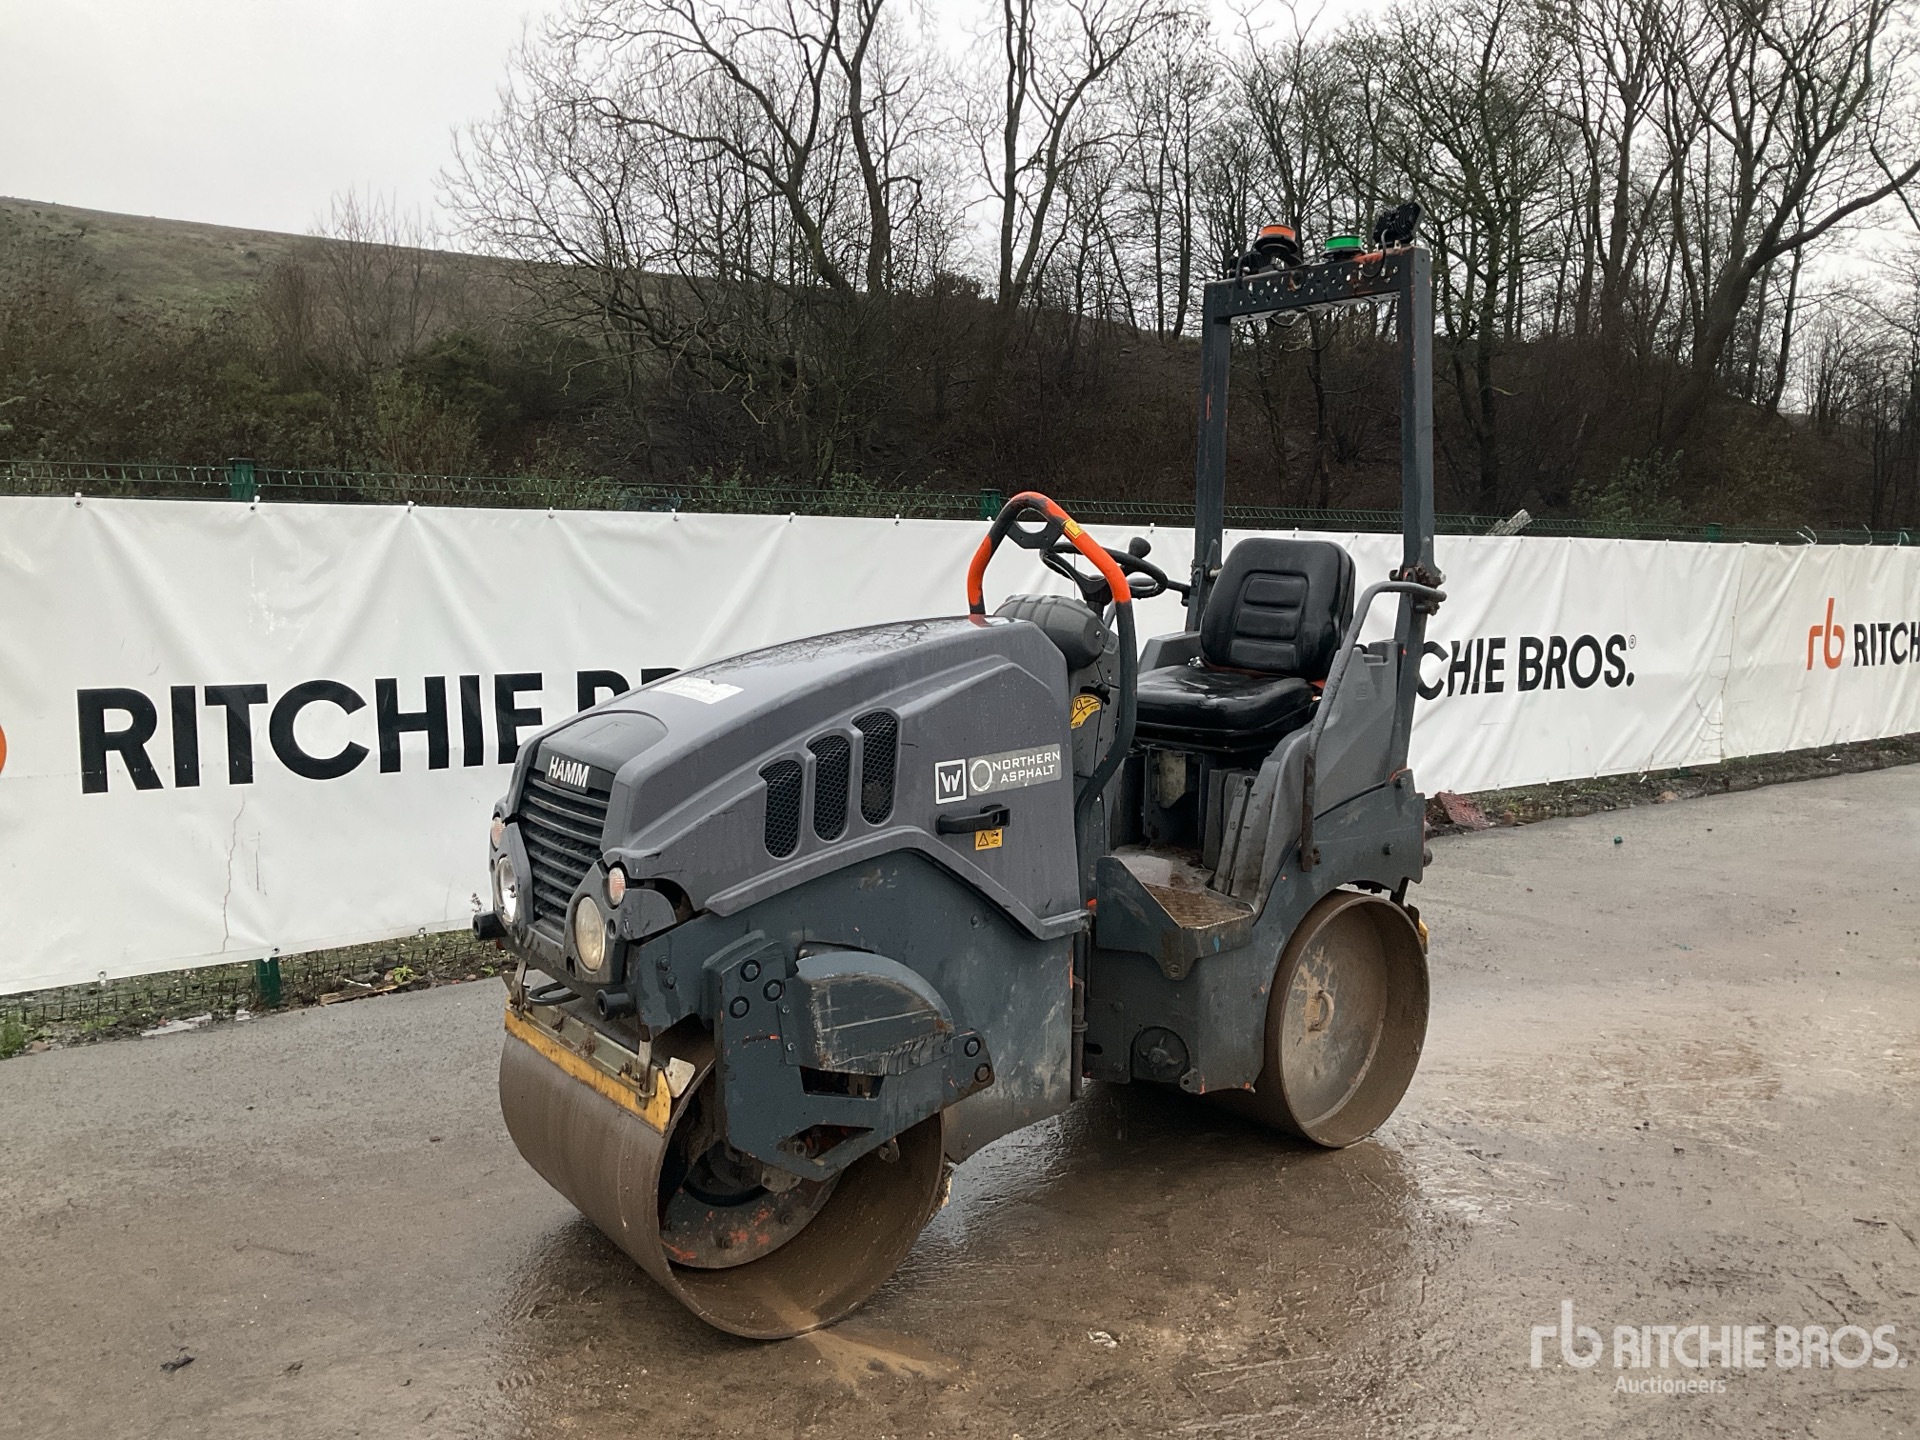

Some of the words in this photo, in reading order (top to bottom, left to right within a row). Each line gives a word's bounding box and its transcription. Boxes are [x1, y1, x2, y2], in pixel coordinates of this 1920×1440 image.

[1853, 621, 1920, 667] RITCH
[1416, 637, 1506, 700] CHIE
[77, 672, 544, 795] RITCHIE
[548, 755, 590, 788] HAMM
[992, 750, 1061, 772] NORTHERN
[1000, 764, 1056, 784] ASPHALT
